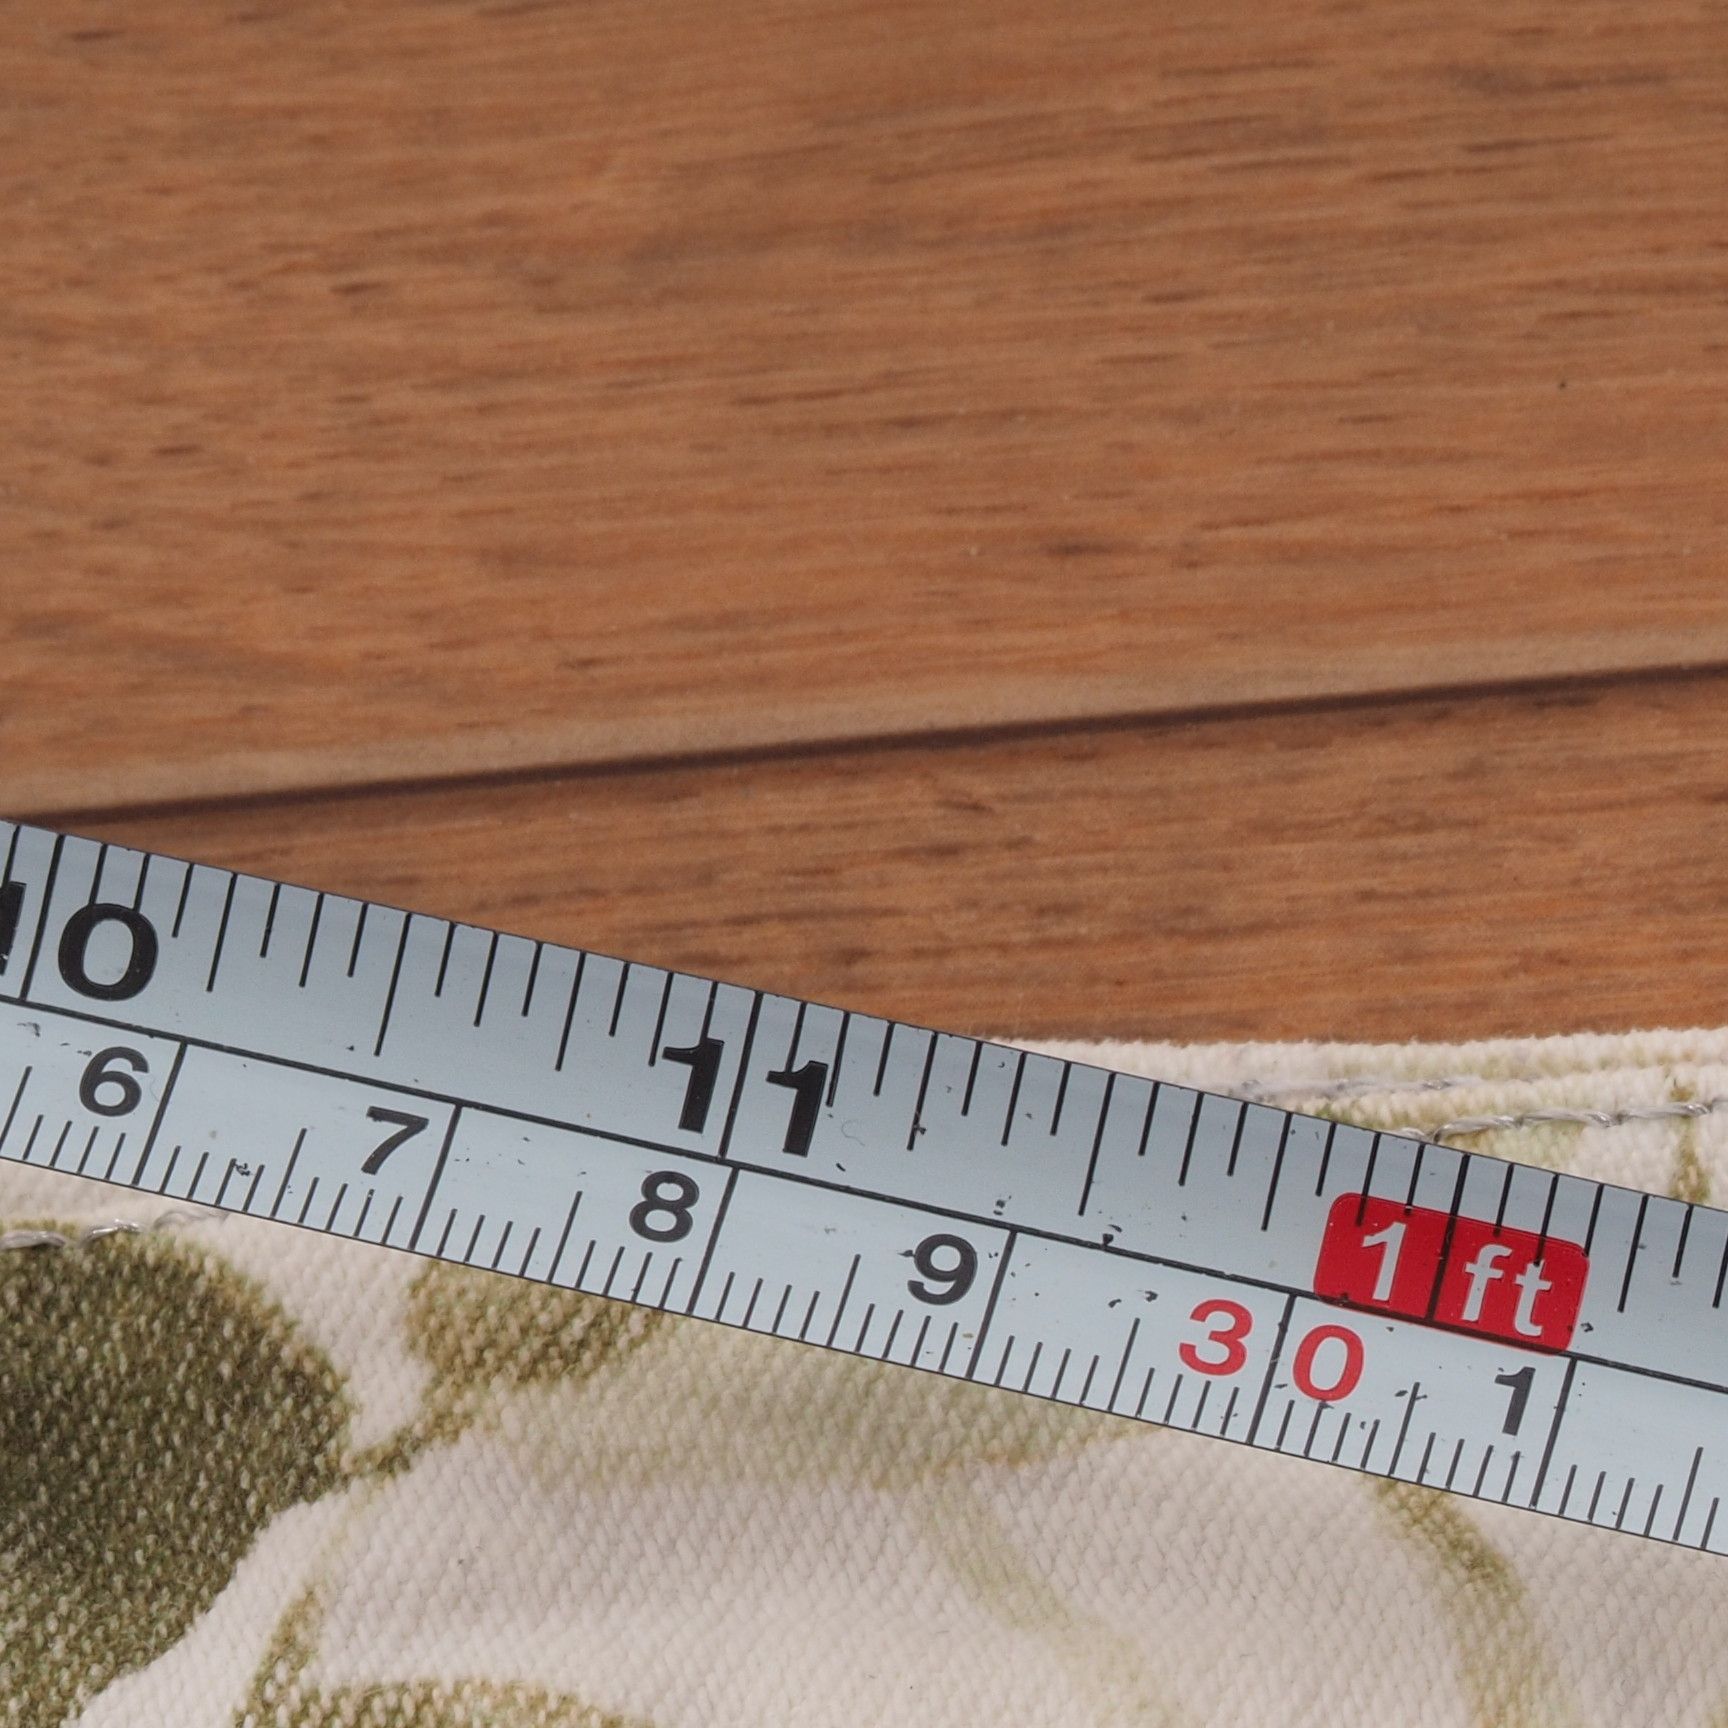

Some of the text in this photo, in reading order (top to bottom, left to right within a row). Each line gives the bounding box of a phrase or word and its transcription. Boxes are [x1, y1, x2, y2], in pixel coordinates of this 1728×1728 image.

[79, 1047, 150, 1118] 6
[366, 1106, 428, 1175] 7
[628, 1171, 700, 1244] 8
[907, 1233, 977, 1305] 9
[1178, 1299, 1365, 1401] 30
[1494, 1366, 1536, 1436] 1
[662, 1037, 828, 1157] 11
[1360, 1222, 1408, 1302] 1
[1461, 1244, 1552, 1339] ft
